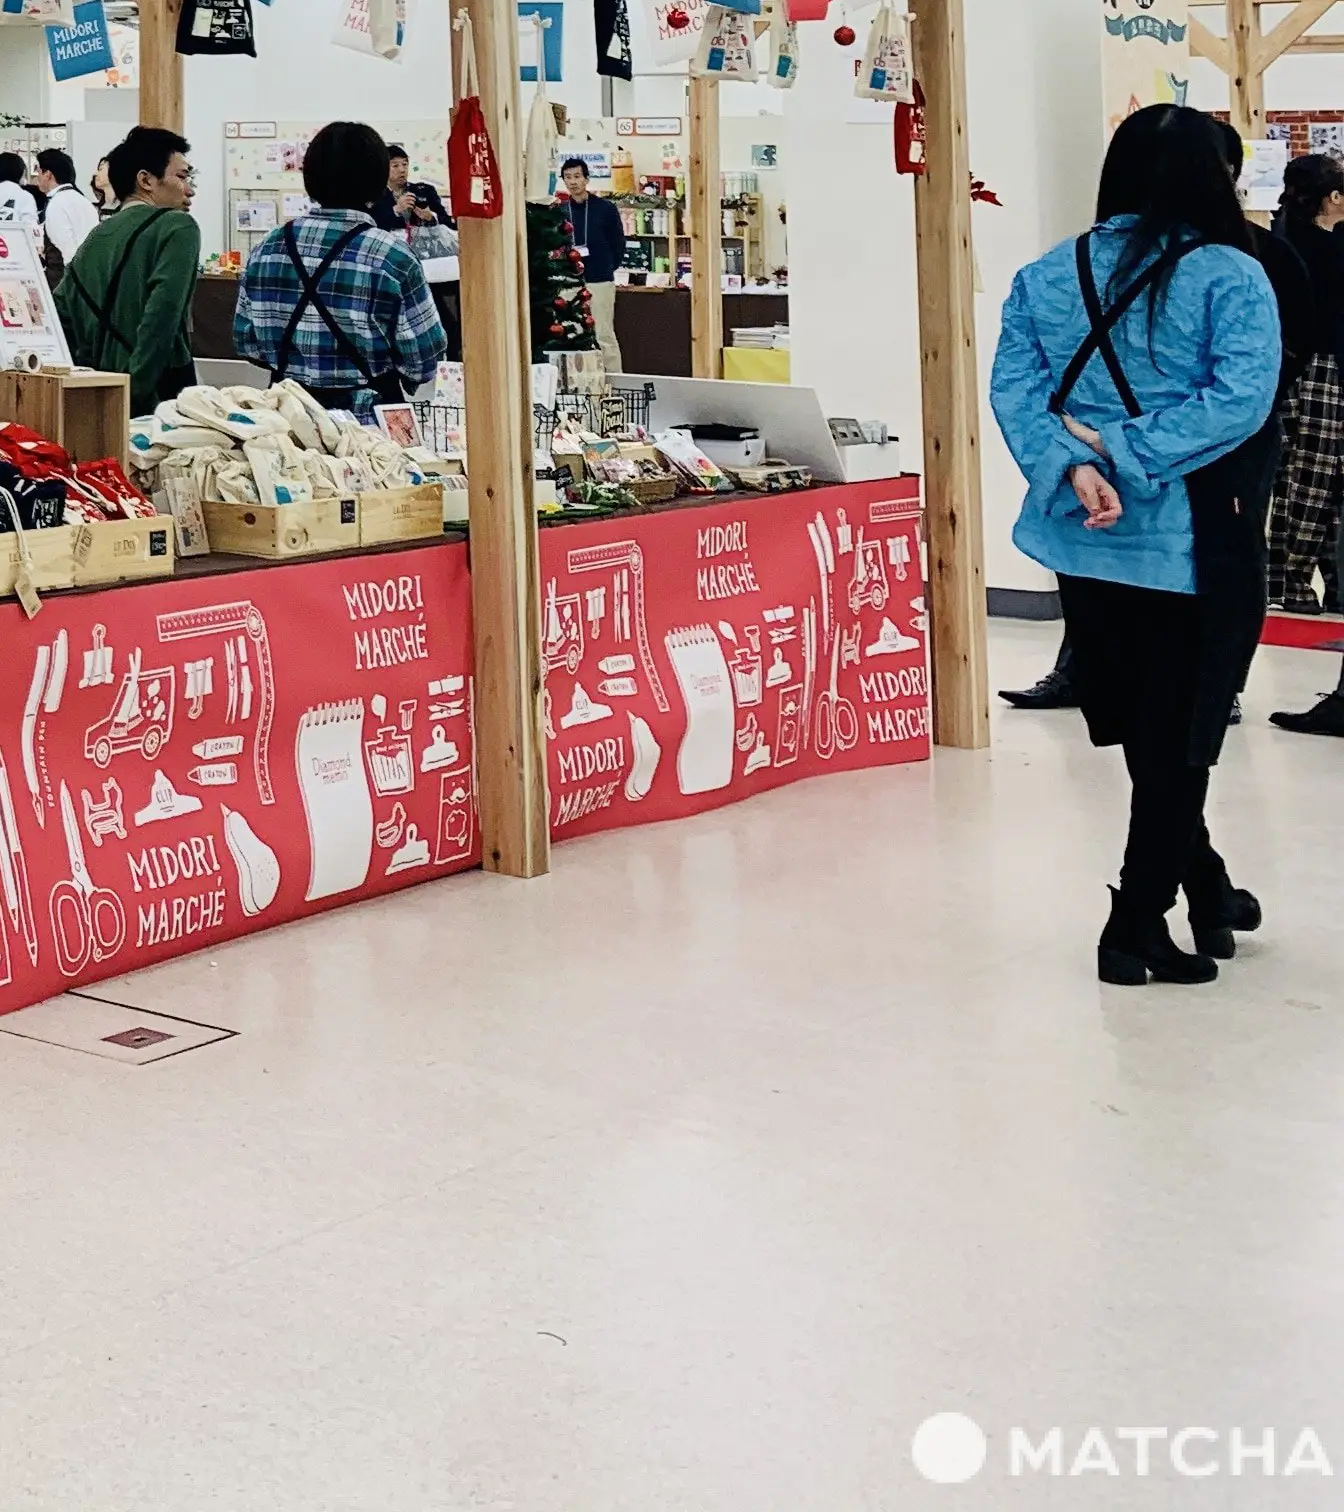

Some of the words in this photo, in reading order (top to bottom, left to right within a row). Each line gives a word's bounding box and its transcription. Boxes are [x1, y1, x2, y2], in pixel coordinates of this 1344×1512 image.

[53, 18, 101, 45] MIDORI
[619, 121, 631, 132] 65
[697, 520, 748, 559] MIDORI
[342, 574, 425, 621] MIDORI
[697, 553, 761, 601] MARCHÉ
[354, 615, 429, 671] MARCHÉ
[858, 666, 928, 704] MIDORI
[865, 706, 930, 745] MARCH
[556, 737, 625, 784] MIDORI
[155, 787, 173, 805] CLIP
[127, 834, 220, 893] MIDORI
[135, 878, 226, 948] MARCHÉ
